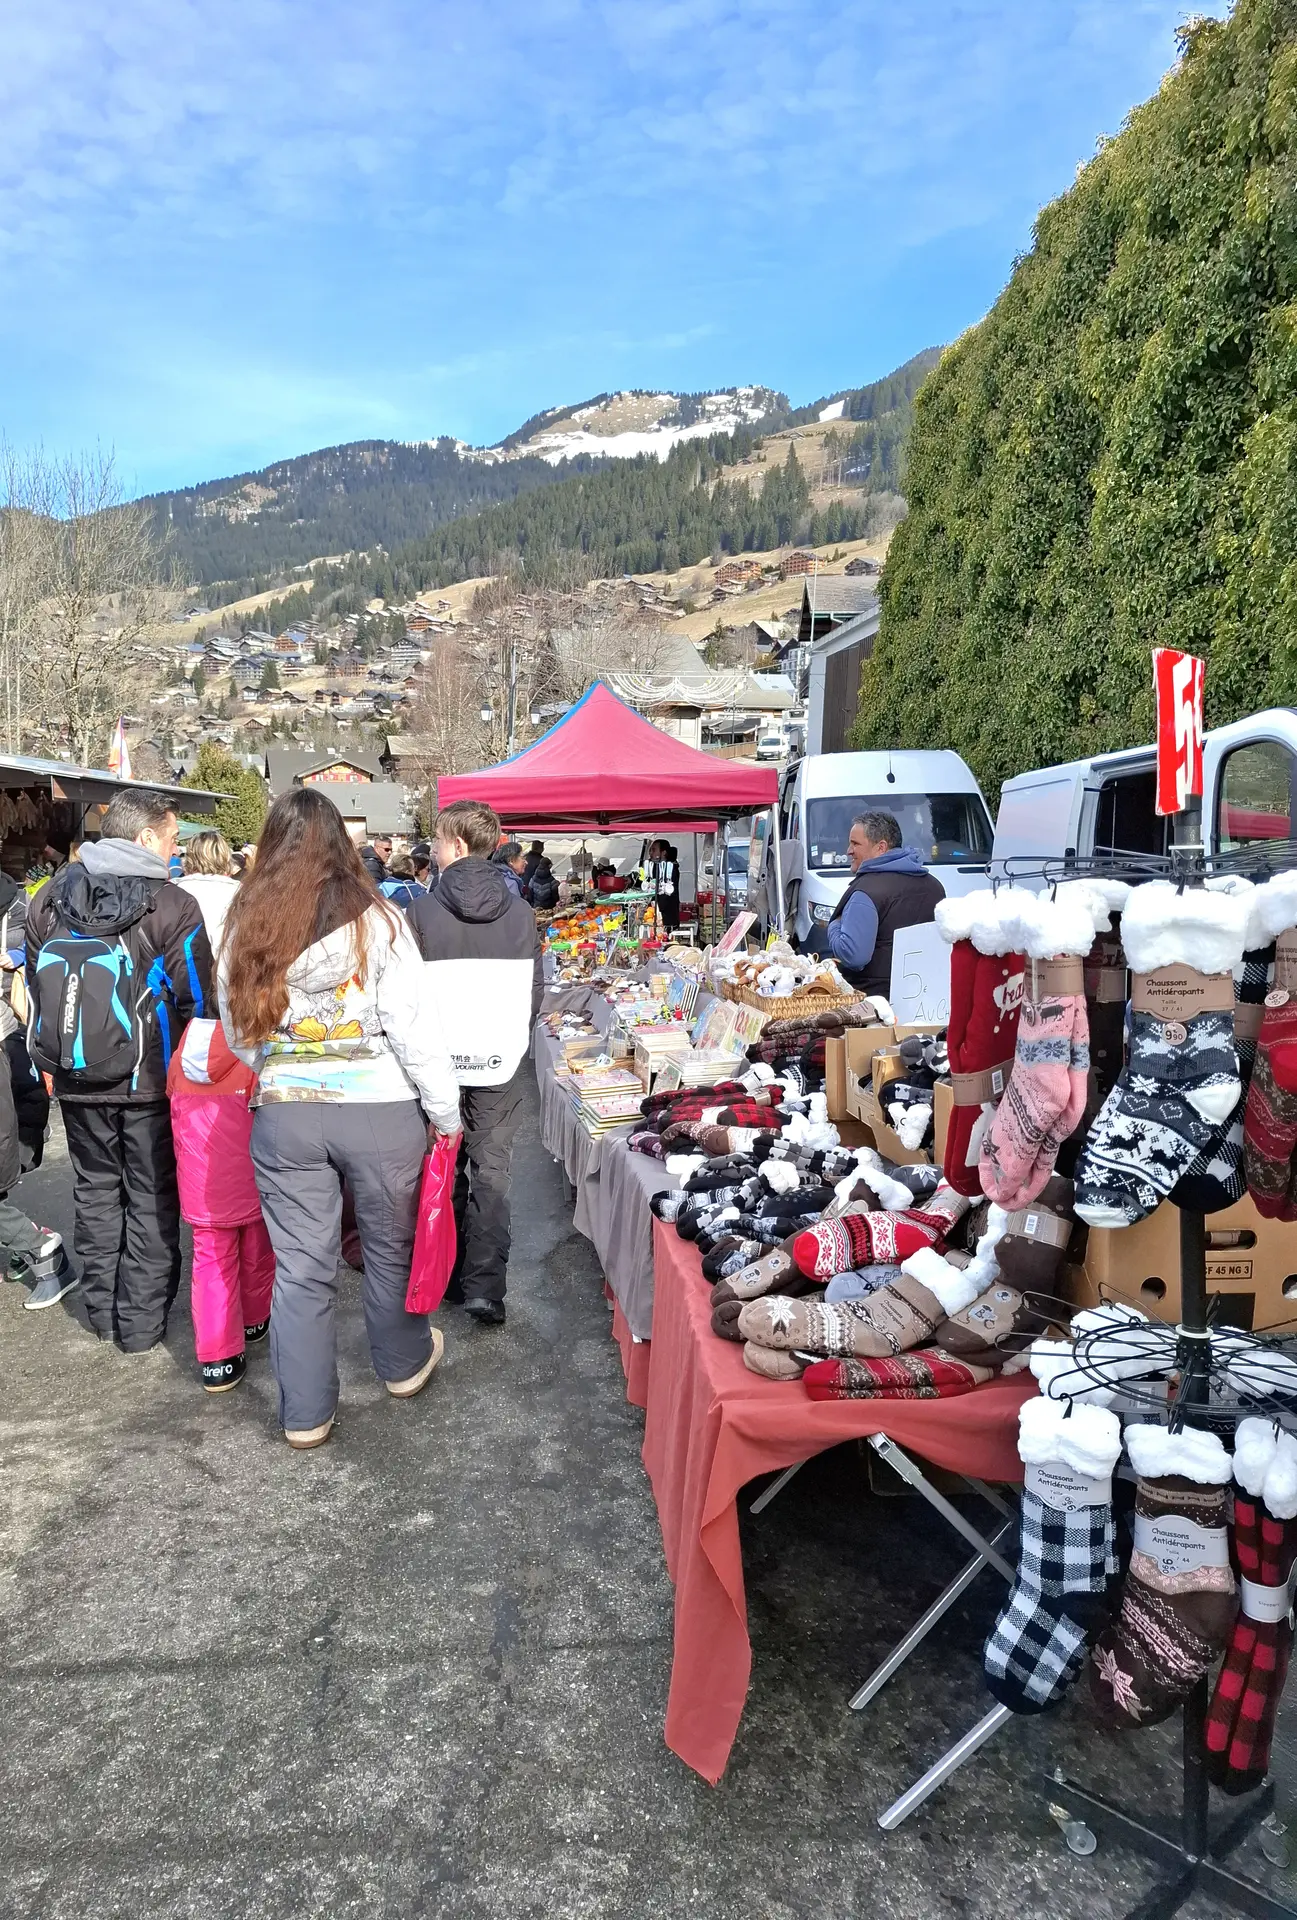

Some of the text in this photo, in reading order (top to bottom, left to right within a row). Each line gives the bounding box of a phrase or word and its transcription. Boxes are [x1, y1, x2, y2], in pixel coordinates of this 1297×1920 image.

[1146, 979, 1188, 987] Chaussons
[1146, 987, 1205, 997] Antidérapants
[1215, 1266, 1226, 1275] 45
[1228, 1266, 1242, 1275] NG
[1244, 1266, 1250, 1274] 3
[1037, 1469, 1074, 1483] Chaussons
[1037, 1478, 1089, 1492] Antidérapants
[1151, 1528, 1190, 1540] Chaussons
[1152, 1536, 1206, 1550] Antidérapants
